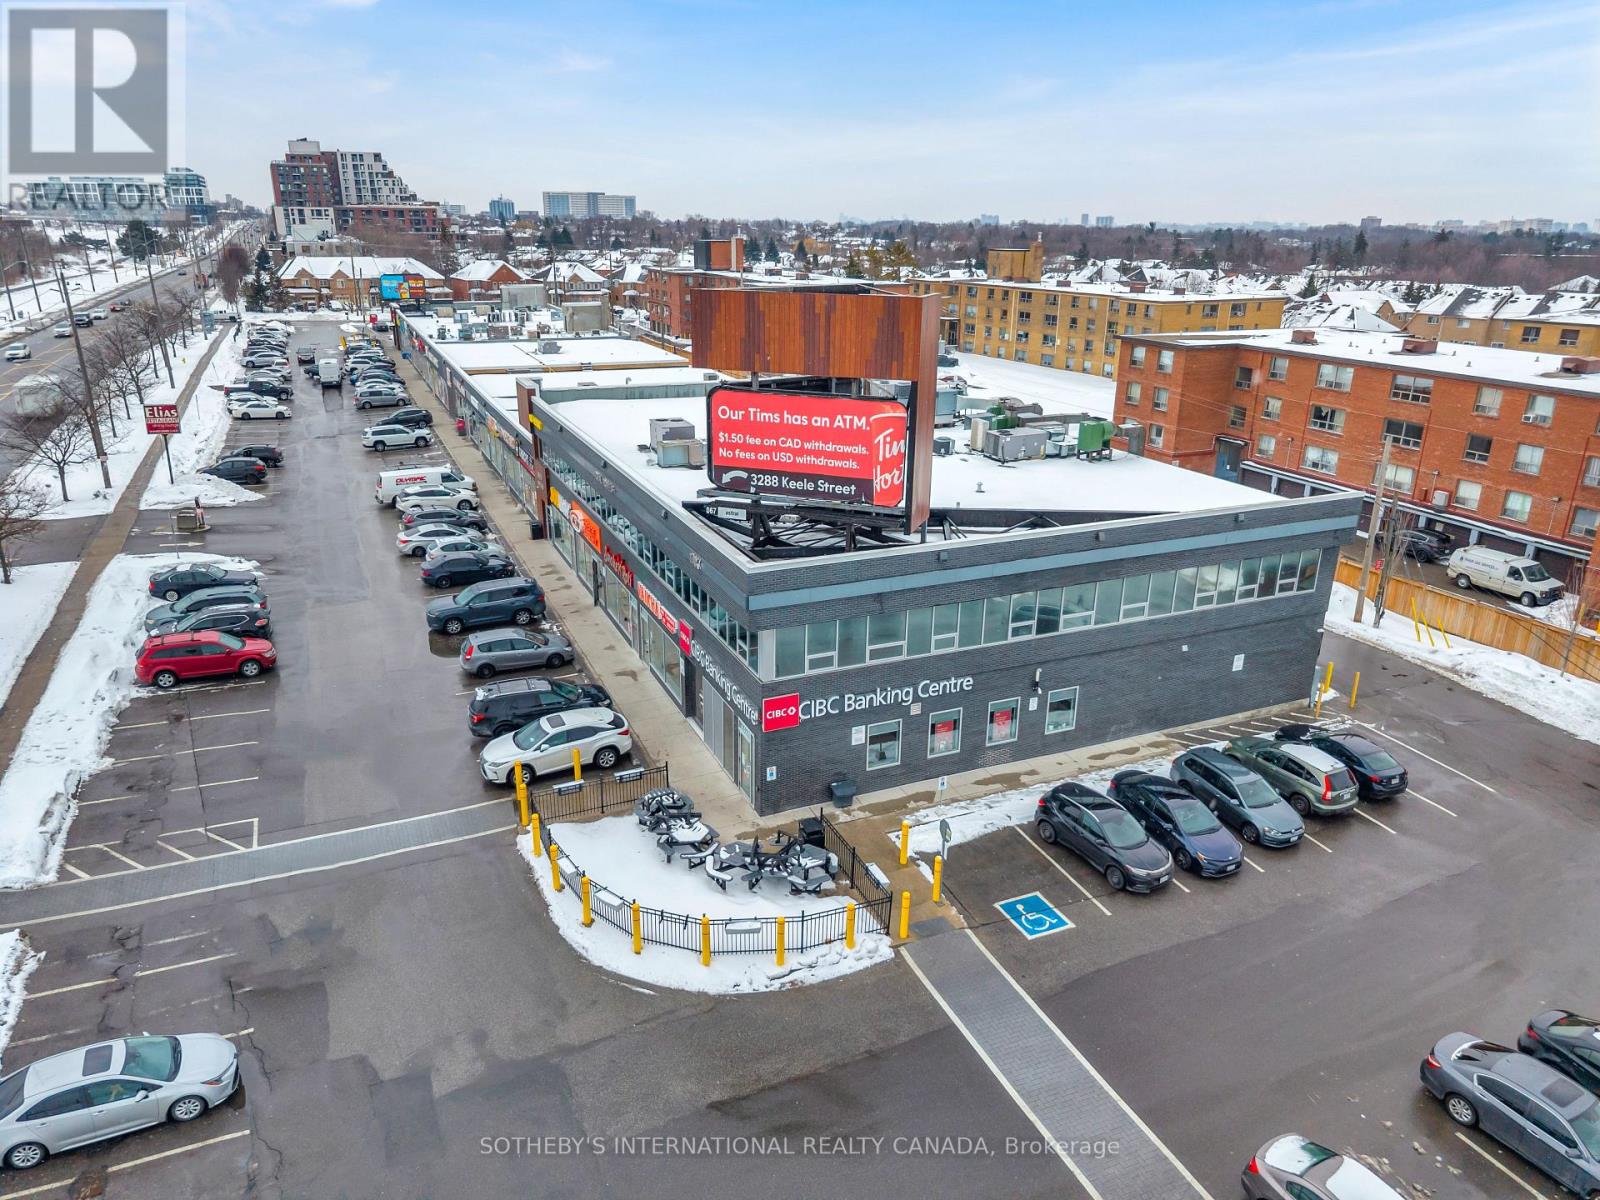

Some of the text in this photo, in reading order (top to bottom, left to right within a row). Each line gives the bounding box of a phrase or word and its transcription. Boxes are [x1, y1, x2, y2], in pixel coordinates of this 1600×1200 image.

[718, 405, 871, 431] Our Tims has an ATM.
[718, 431, 870, 455] $1.50 fee on CAD withdrawals.
[719, 447, 861, 469] No fees on USD withdrawals.
[750, 473, 856, 496] 3288 Keele Street
[691, 640, 705, 667] CIBC
[705, 654, 731, 701] Banking
[732, 685, 758, 725] Centre
[799, 676, 974, 720] CIBC Banking Centre
[766, 708, 788, 720] CIBC
